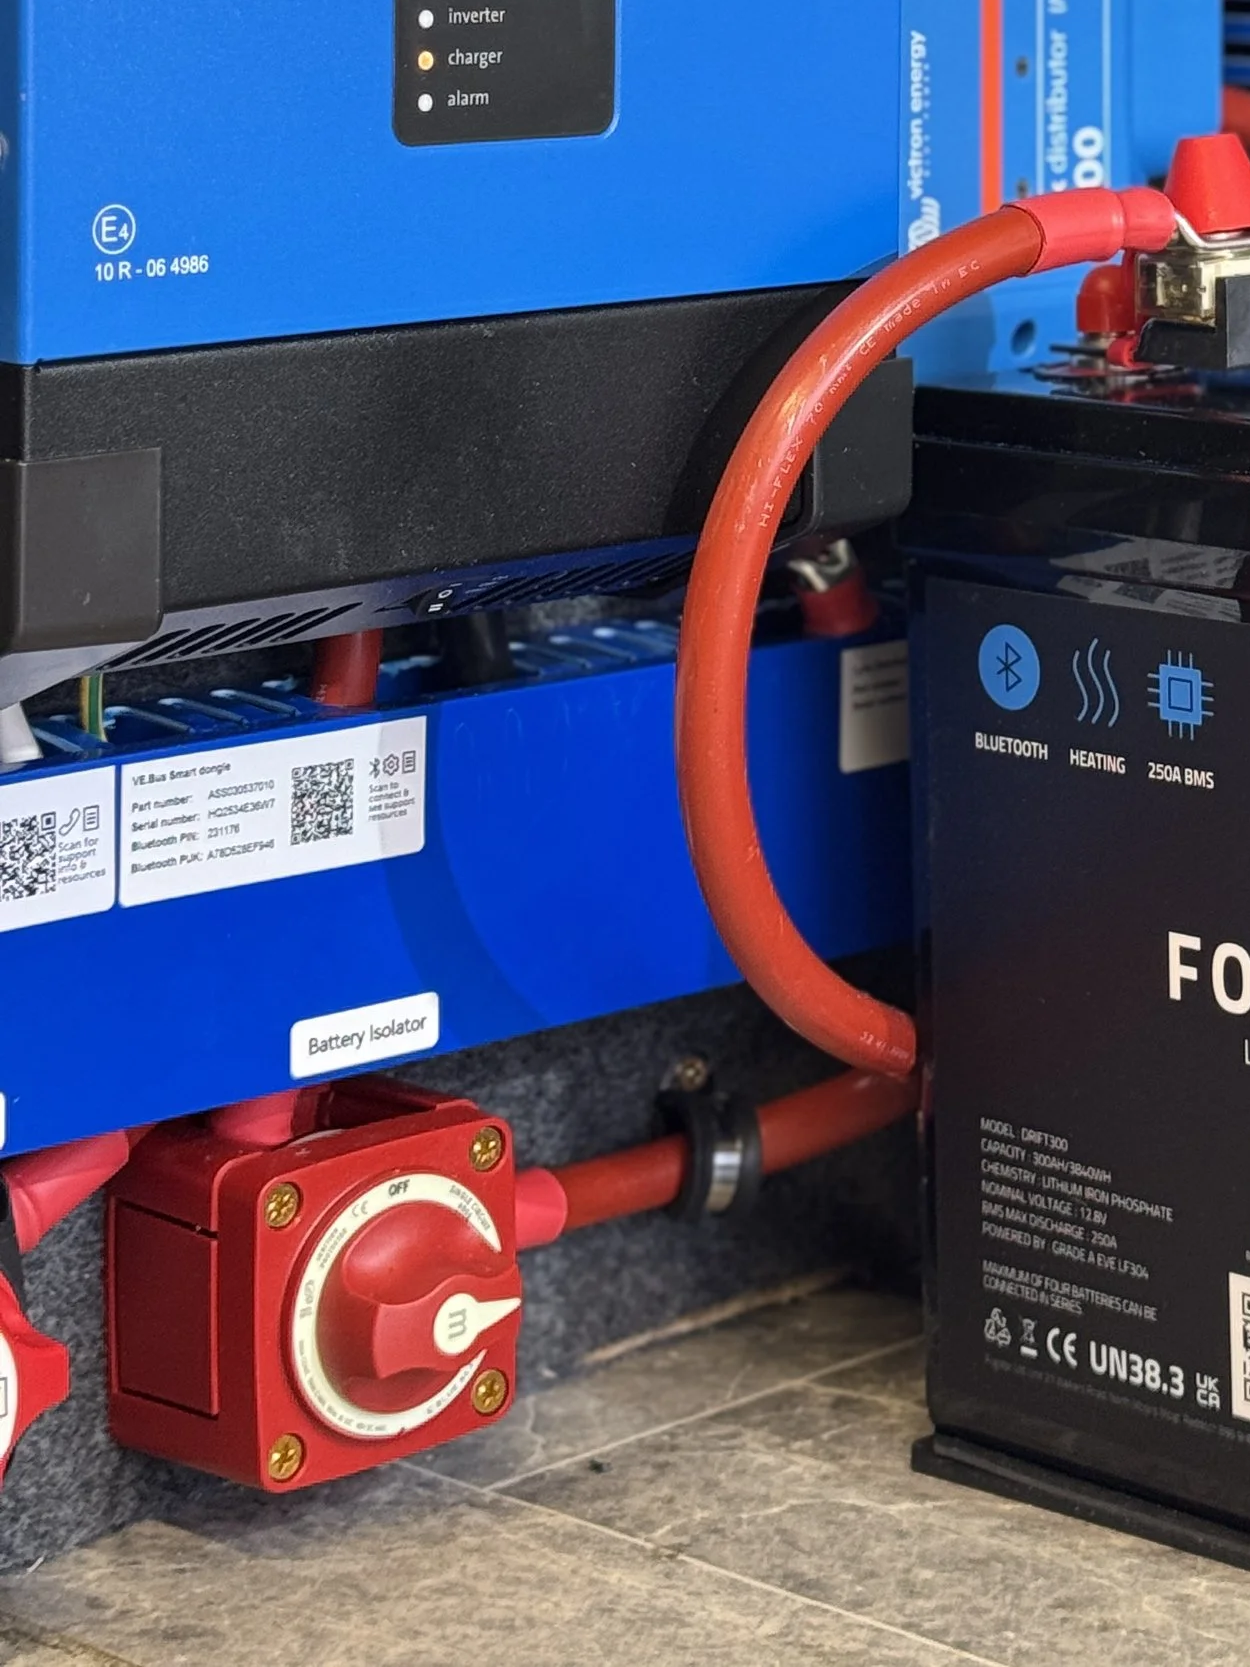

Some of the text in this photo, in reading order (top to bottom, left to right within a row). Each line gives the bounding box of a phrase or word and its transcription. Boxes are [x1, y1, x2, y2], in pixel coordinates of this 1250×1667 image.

[448, 6, 506, 24] inverter
[447, 48, 504, 69] charger
[447, 89, 490, 107] alarm
[1045, 29, 1068, 172] distributor
[907, 30, 927, 200] victron energy
[95, 254, 209, 282] 10 R 06 4986
[884, 298, 921, 334] made
[958, 260, 981, 279] EC
[974, 731, 1049, 761] BLUETOOTH
[169, 767, 197, 781] Smart
[1069, 748, 1127, 775] HEATING
[1148, 761, 1215, 790] 250A BMS
[131, 800, 151, 813] Part
[131, 818, 159, 833] Serial
[130, 834, 178, 852] Bluetooth
[130, 856, 178, 875] Bluetooth
[308, 1014, 427, 1057] Battery Isolator
[980, 1116, 1069, 1152] MODEL DRIFT300
[980, 1137, 1026, 1162] CAPACITY
[387, 1178, 411, 1198] OFF
[981, 1158, 1174, 1223] CHEMISTRY LITHIUM IRON PHOSPHATE
[981, 1179, 1028, 1204] NOMINAL
[1028, 1192, 1073, 1217] VOLTAGE
[981, 1199, 1004, 1218] BMS
[1005, 1206, 1028, 1226] MAX
[1028, 1213, 1085, 1240] DISCHARGE
[981, 1220, 1032, 1247] POWERED
[1032, 1234, 1046, 1250] BY
[1051, 1240, 1086, 1263] GRADE
[982, 1258, 1031, 1285] MAXIMUM
[1044, 1276, 1072, 1295] FOUR
[1072, 1284, 1122, 1310] BATTERIES
[982, 1274, 1039, 1304] CONNECTED
[1050, 1293, 1084, 1316] SERIES
[1089, 1340, 1186, 1400] UN38.3
[1195, 1371, 1220, 1392] UK
[1195, 1388, 1221, 1411] CA
